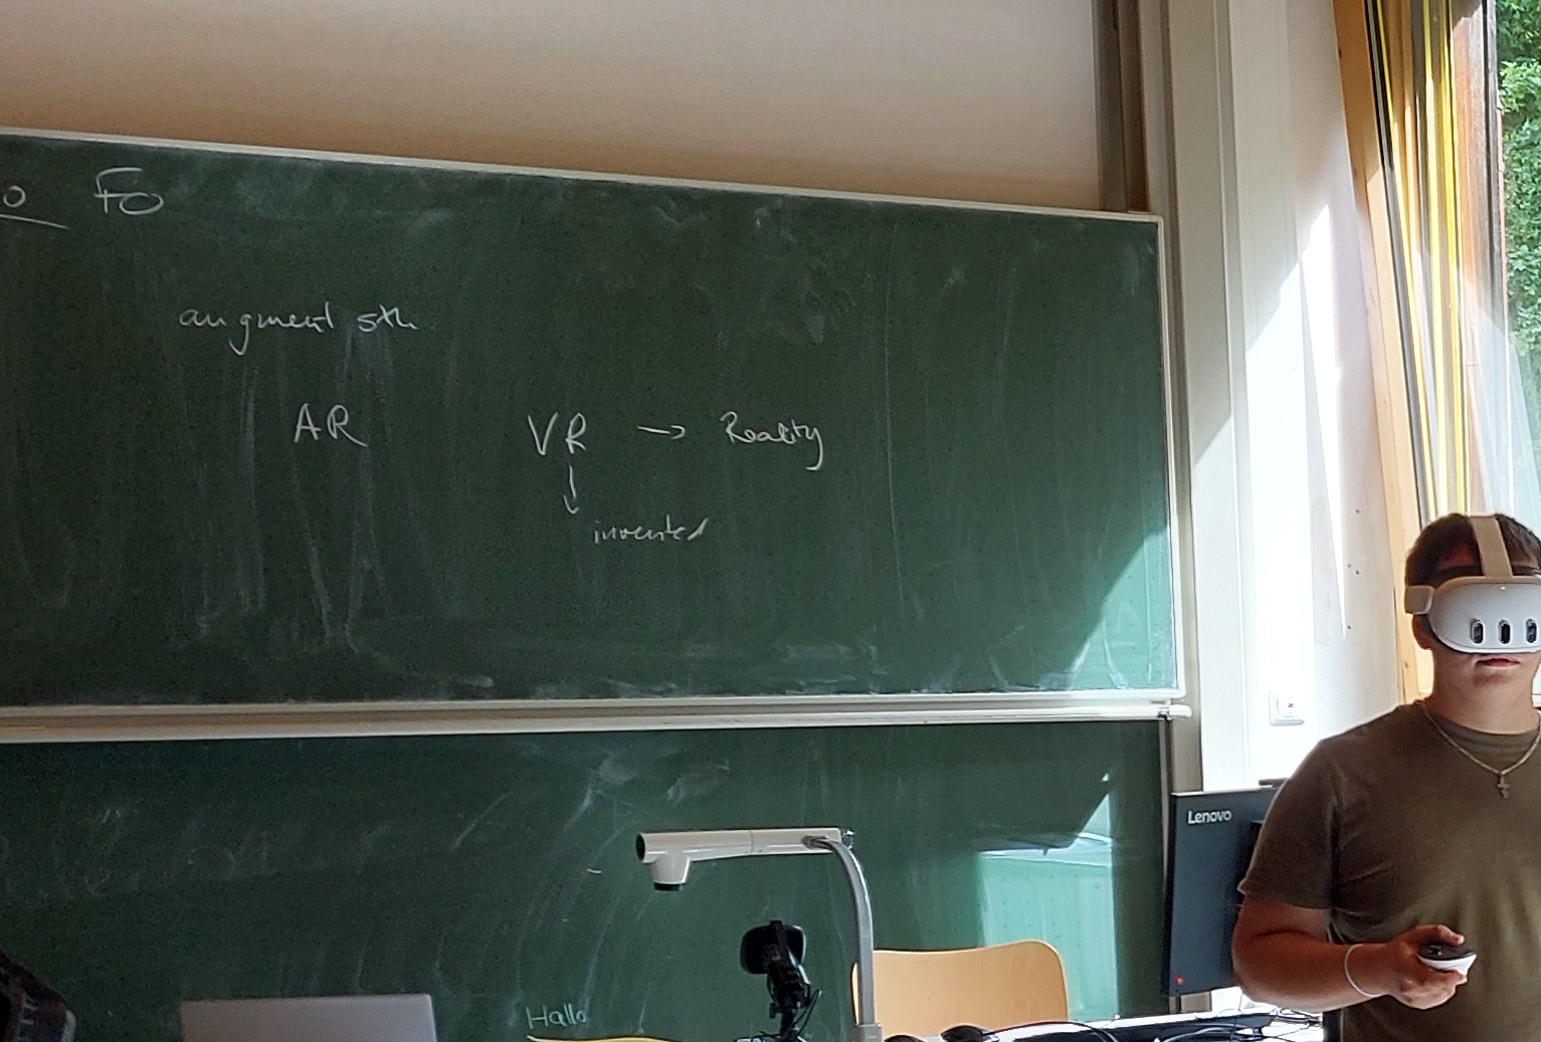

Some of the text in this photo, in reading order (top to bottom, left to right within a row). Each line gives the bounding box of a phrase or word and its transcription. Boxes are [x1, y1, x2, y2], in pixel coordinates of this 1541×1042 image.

[294, 402, 369, 447] AR
[527, 411, 824, 471] VR Reality
[1187, 810, 1232, 824] Lenovo
[525, 1003, 587, 1029] Hallo
